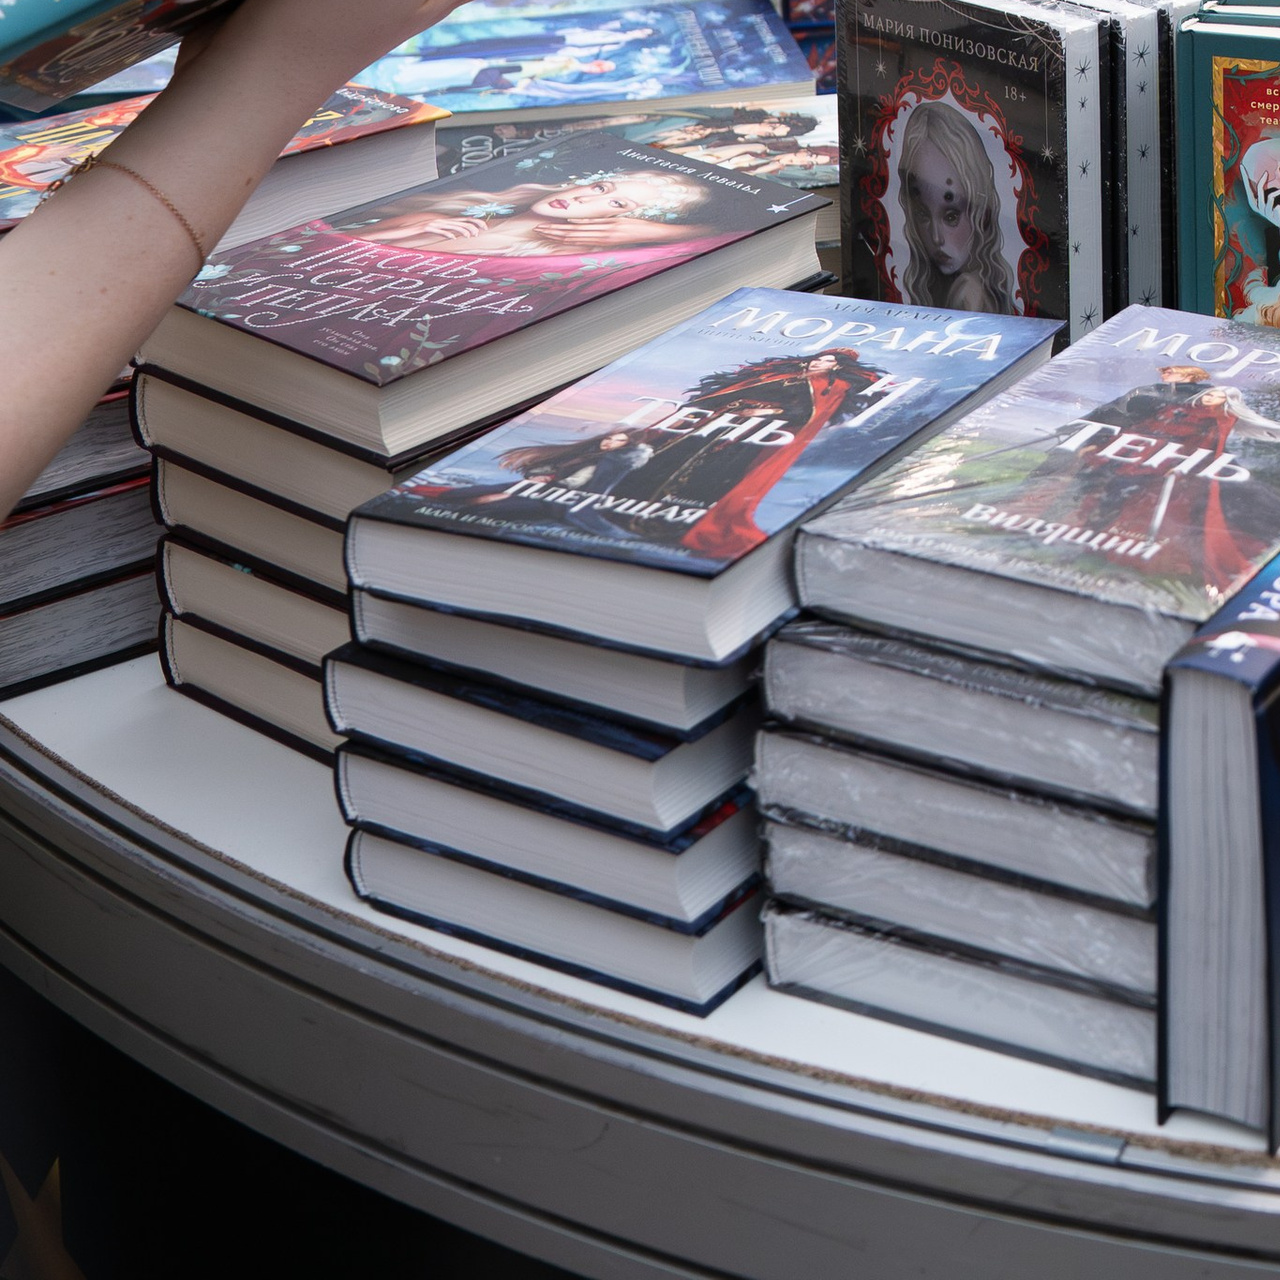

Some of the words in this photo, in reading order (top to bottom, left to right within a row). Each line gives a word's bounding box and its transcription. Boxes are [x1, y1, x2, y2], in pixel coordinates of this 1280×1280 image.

[863, 11, 915, 41] МАРИЯ
[919, 27, 1040, 73] ПОНИЗОВСКАЯ
[1003, 84, 1027, 104] 18+
[616, 148, 696, 175] Анастасия
[697, 171, 762, 195] Левальд
[280, 238, 487, 279] ПЕСНЬ
[230, 284, 415, 328] ПЕПЛА
[309, 268, 533, 321] СЕРДЦА
[708, 306, 1003, 360] МОРАНА
[616, 396, 795, 446] ТЕНЬ
[1057, 419, 1251, 484] ТЕНЬ
[502, 480, 709, 524] ПЛЕТУЩАЯ
